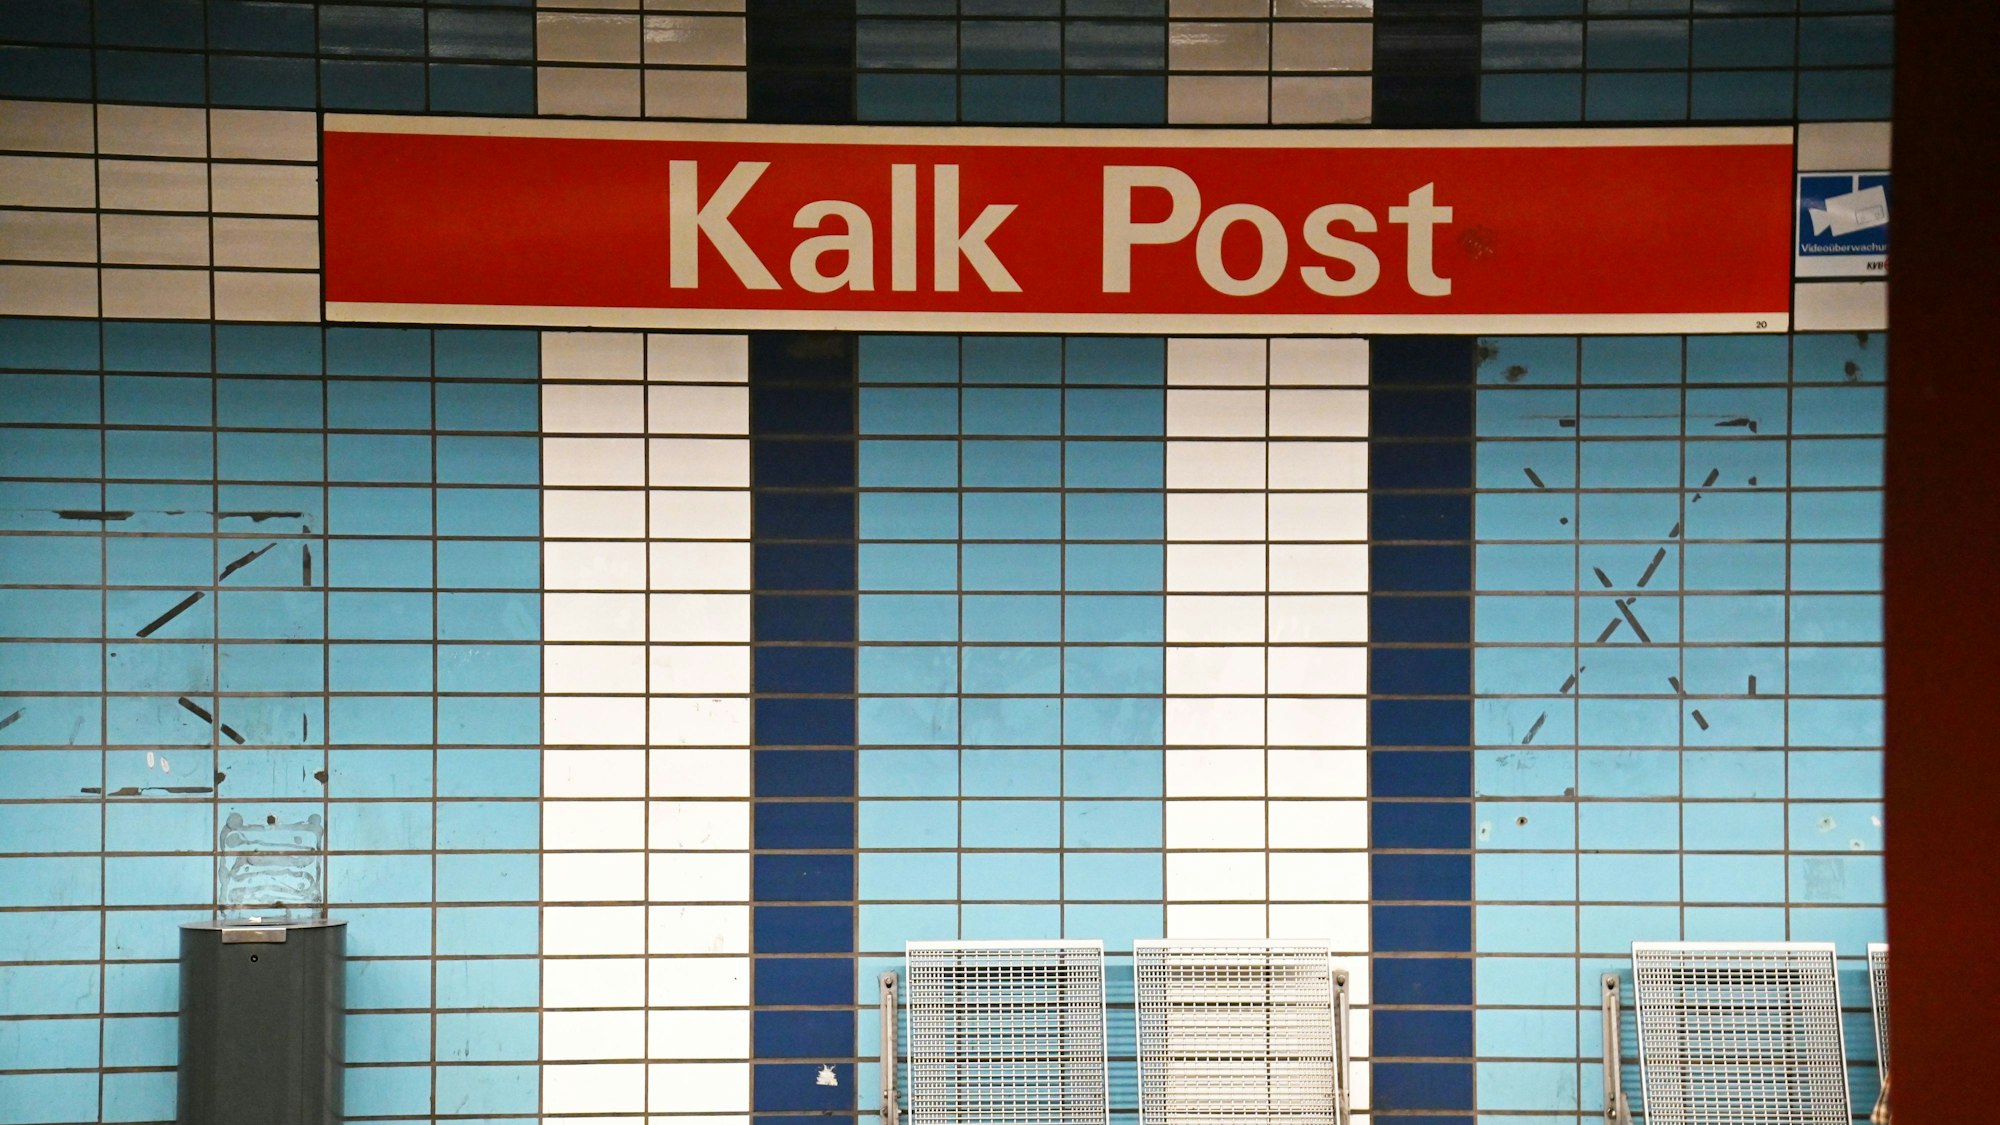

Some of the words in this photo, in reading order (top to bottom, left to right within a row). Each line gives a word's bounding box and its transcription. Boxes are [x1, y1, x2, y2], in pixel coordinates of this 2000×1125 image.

[669, 161, 1023, 293] Kalk
[1102, 165, 1453, 297] Post
[1756, 320, 1768, 329] 20
